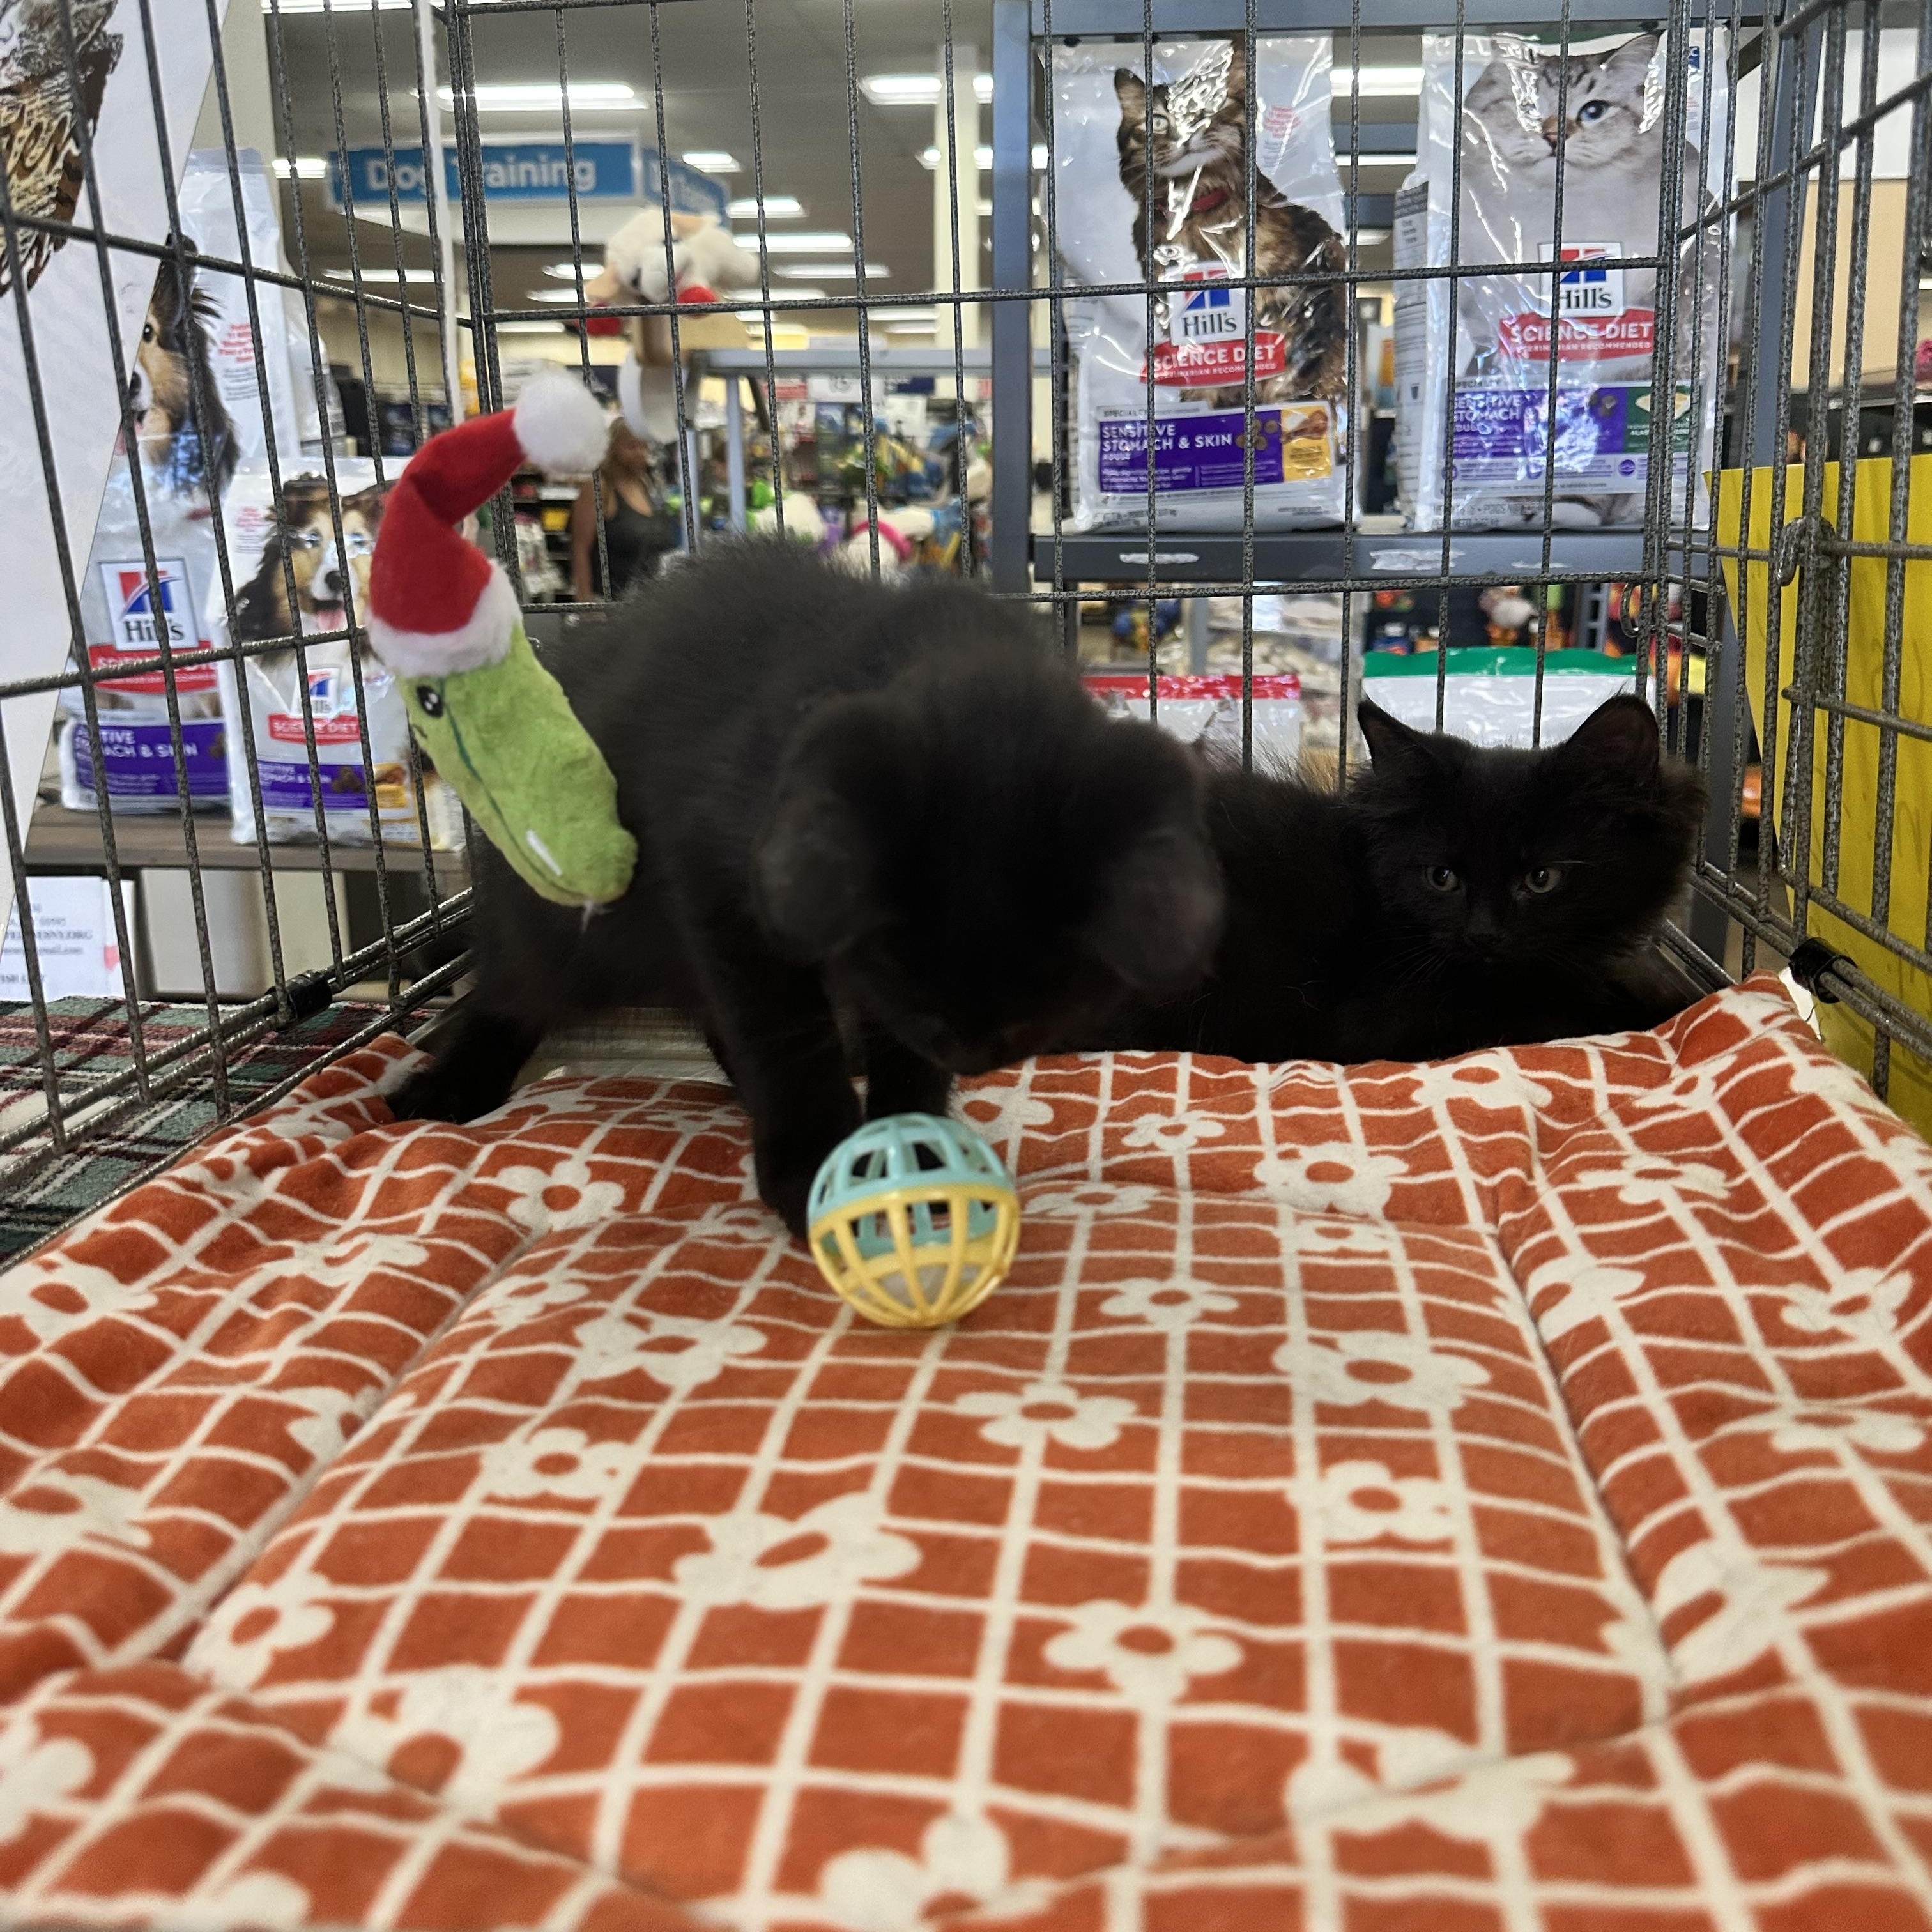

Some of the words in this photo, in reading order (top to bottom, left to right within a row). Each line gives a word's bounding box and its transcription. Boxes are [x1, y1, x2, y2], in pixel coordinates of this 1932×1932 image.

[450, 153, 597, 192] aining
[1183, 312, 1238, 337] Hill's
[1606, 321, 1653, 339] DIET
[1233, 344, 1276, 362] DET
[1102, 424, 1176, 439] SENSITVE
[1178, 436, 1190, 449] &
[1194, 433, 1233, 448] SKIN
